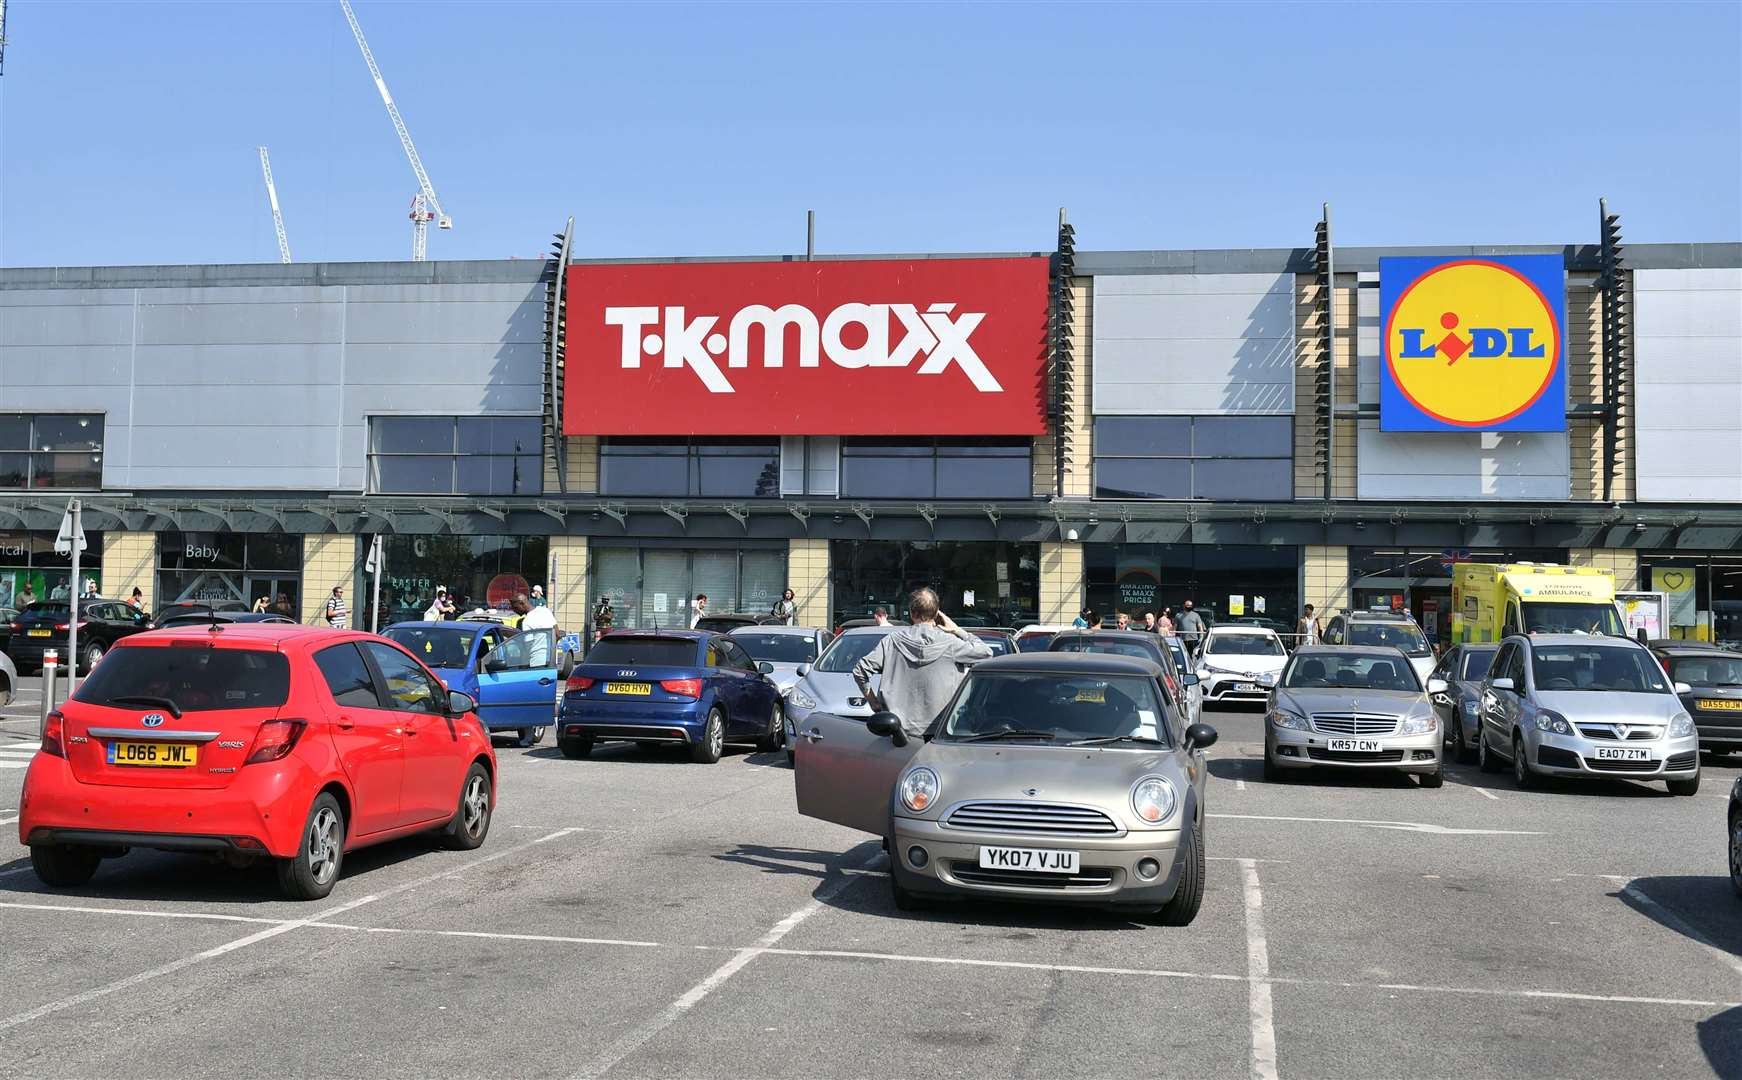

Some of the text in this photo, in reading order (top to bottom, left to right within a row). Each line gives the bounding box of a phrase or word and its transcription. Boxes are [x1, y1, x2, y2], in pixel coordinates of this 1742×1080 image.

[186, 544, 220, 561] Baby
[1537, 588, 1594, 597] AMBULANCE
[632, 684, 649, 694] HYN
[1332, 740, 1378, 751] KR57 CNY
[117, 744, 192, 762] LO66 JWL
[1600, 749, 1647, 759] EA07 ZTM
[988, 849, 1072, 869] YK07 VJU
